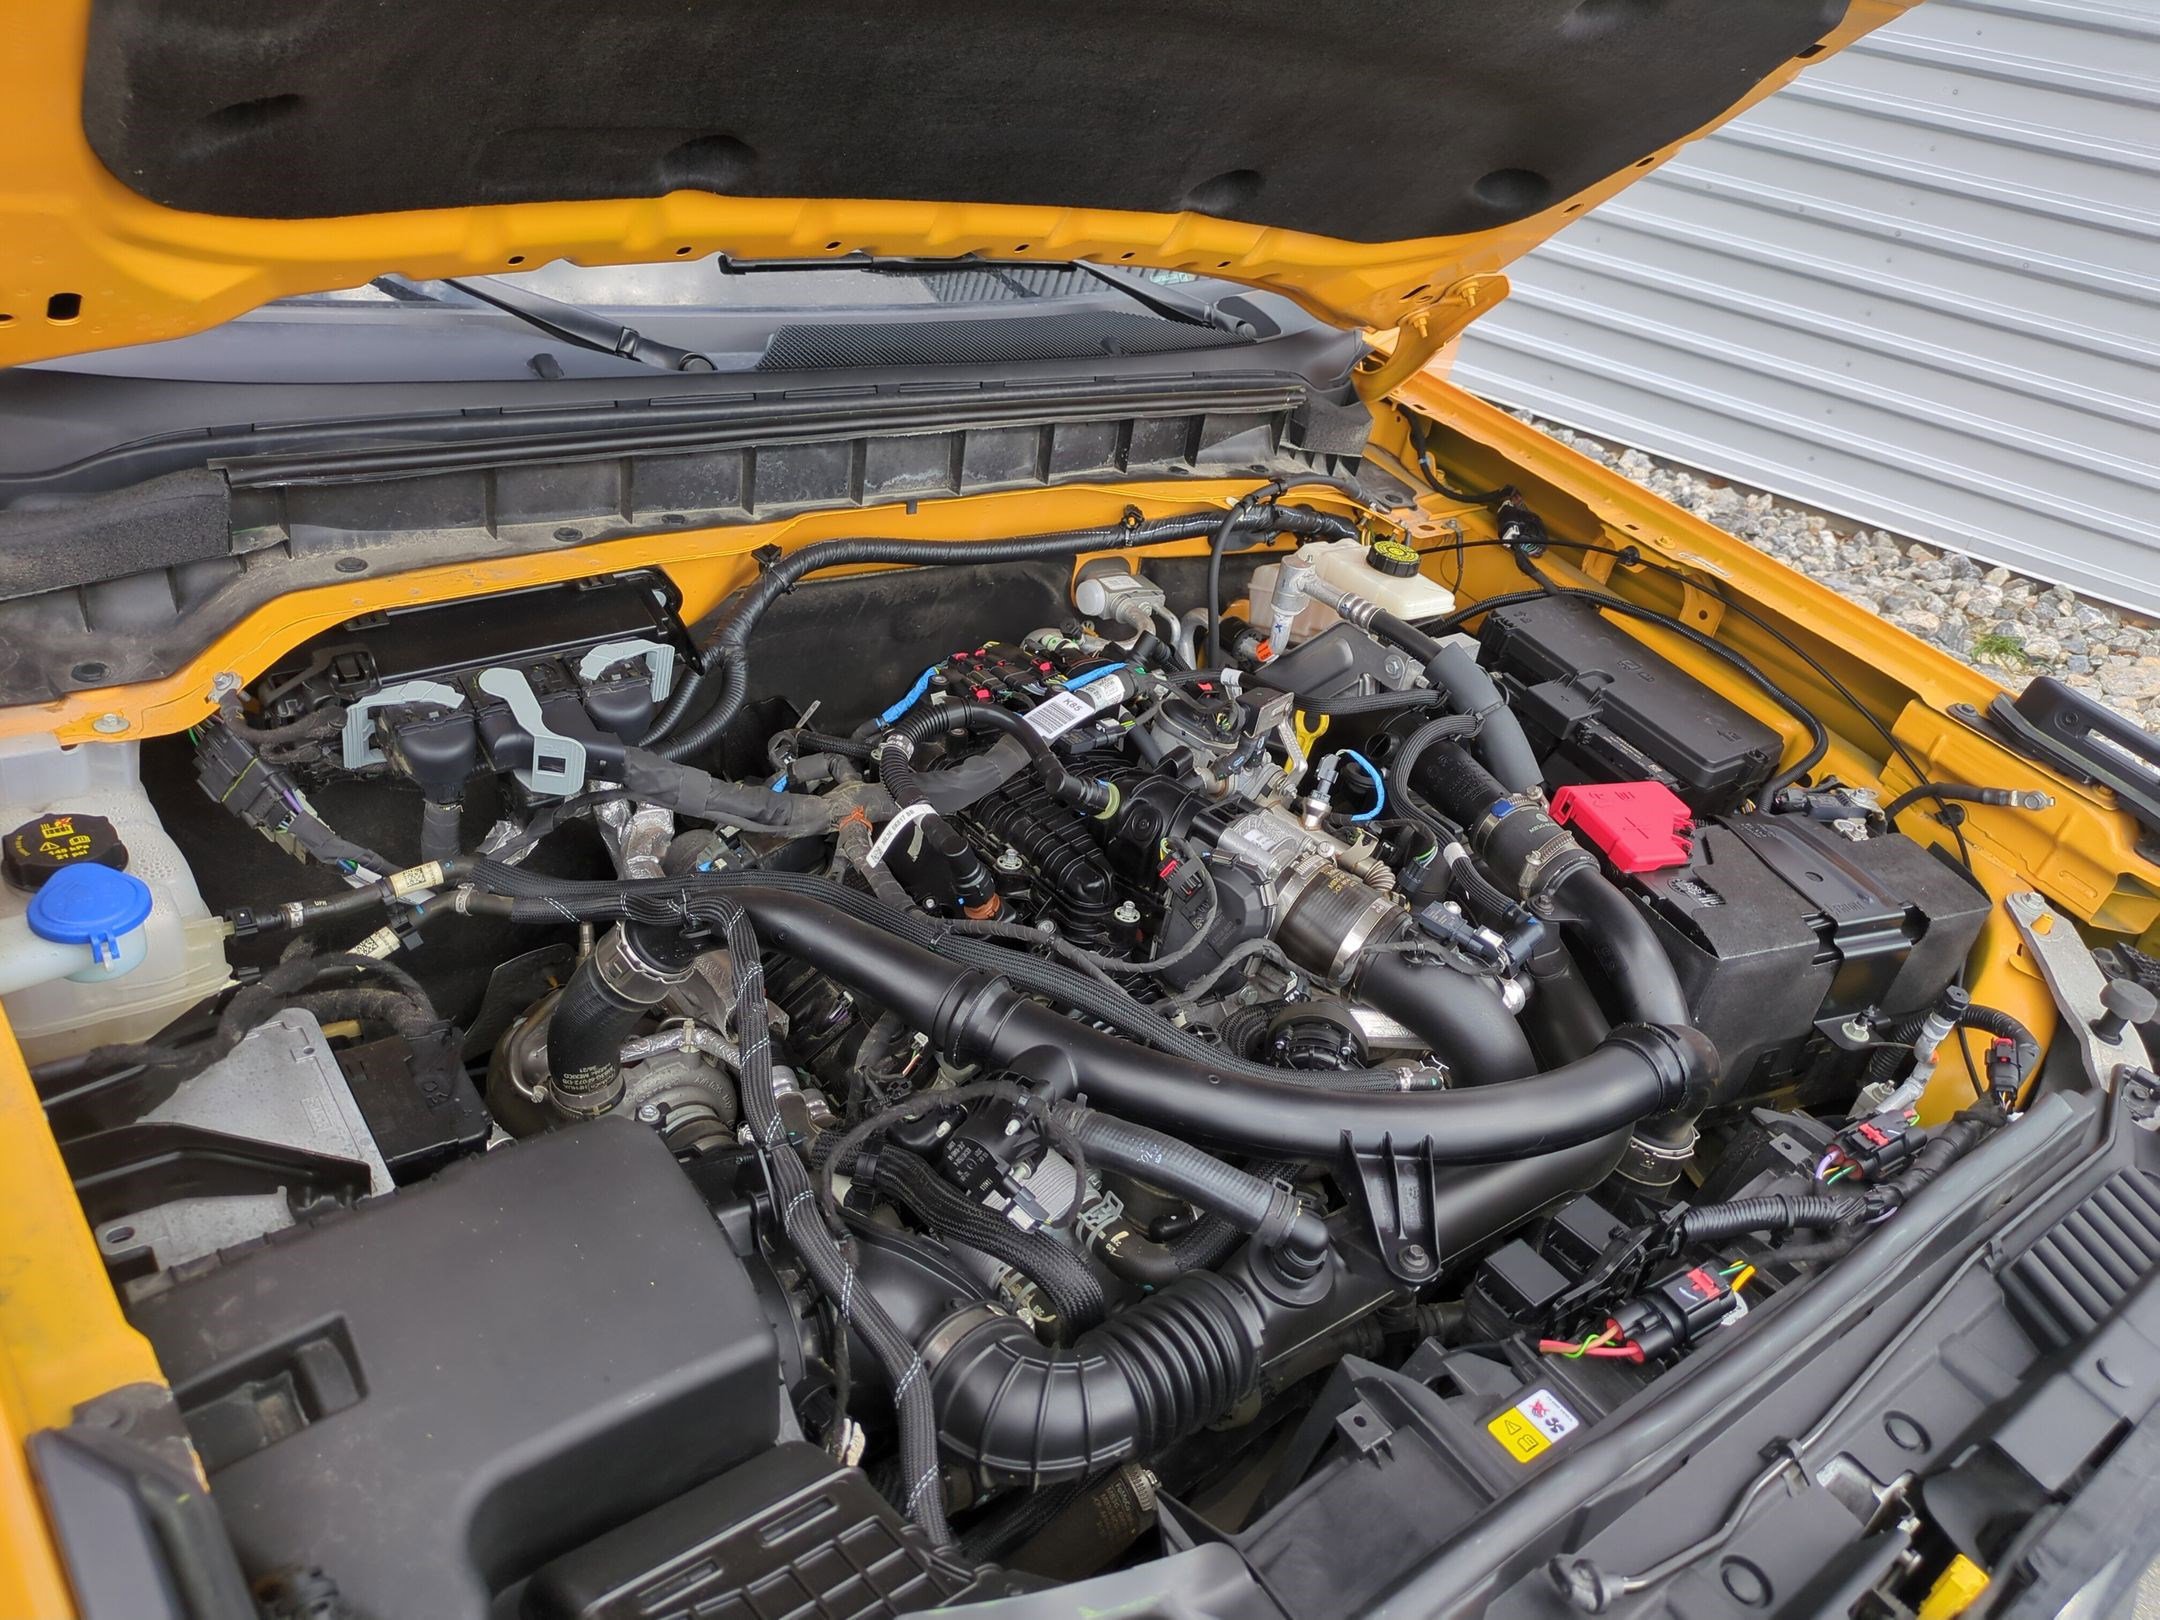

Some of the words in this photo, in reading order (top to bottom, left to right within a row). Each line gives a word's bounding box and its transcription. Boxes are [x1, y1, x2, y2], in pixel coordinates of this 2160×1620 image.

[1063, 698, 1083, 712] K85
[48, 848, 68, 856] 145
[69, 844, 91, 852] kPa
[71, 850, 88, 858] psi
